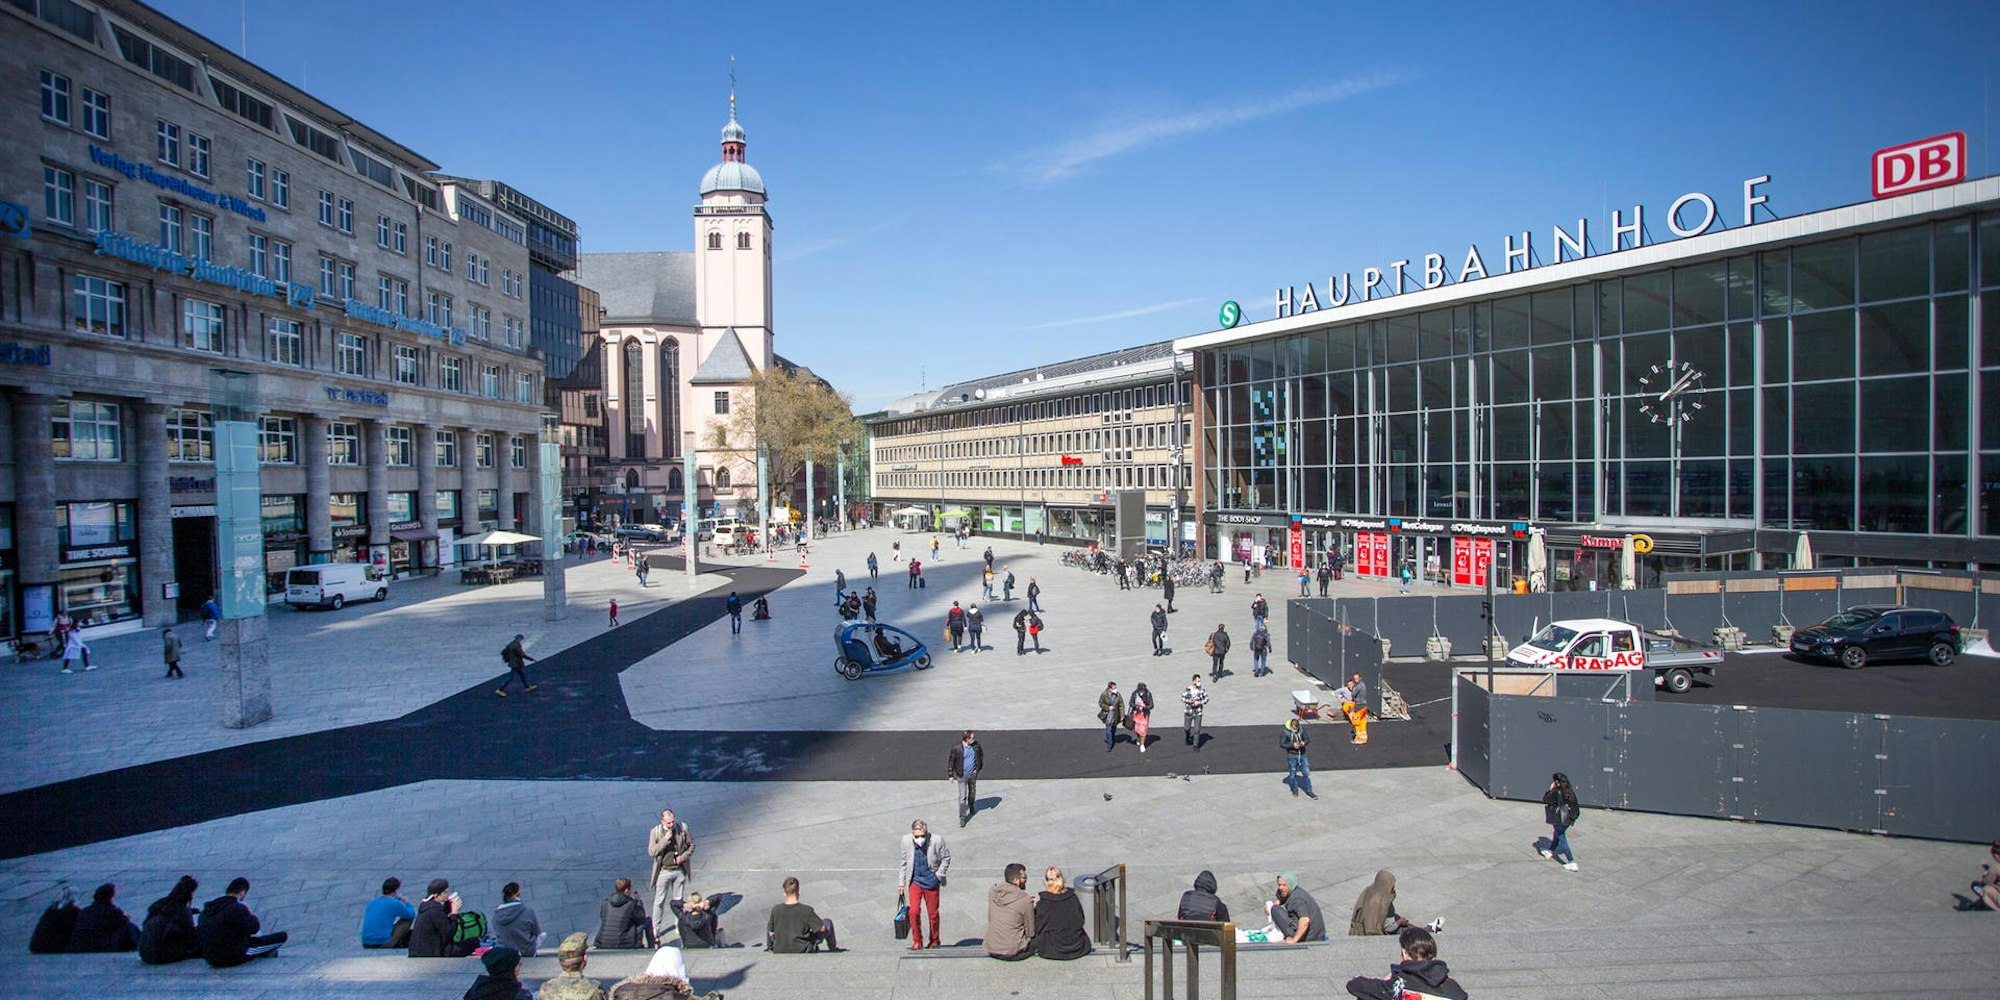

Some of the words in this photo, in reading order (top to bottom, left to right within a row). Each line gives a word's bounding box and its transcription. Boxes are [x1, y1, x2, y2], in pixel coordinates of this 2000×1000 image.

[88, 144, 136, 180] Verlag
[1883, 144, 1951, 189] DB
[1275, 175, 1771, 319] HAUPTBAHNHOF
[1222, 303, 1235, 325] S
[1217, 515, 1229, 523] THE
[1229, 515, 1245, 523] BODY
[1245, 515, 1262, 524] SHOP
[1402, 521, 1444, 532] NetCologne
[341, 527, 367, 536] Santander
[1580, 534, 1625, 550] Kamps
[66, 549, 90, 560] TIME
[90, 546, 128, 558] SQUARE
